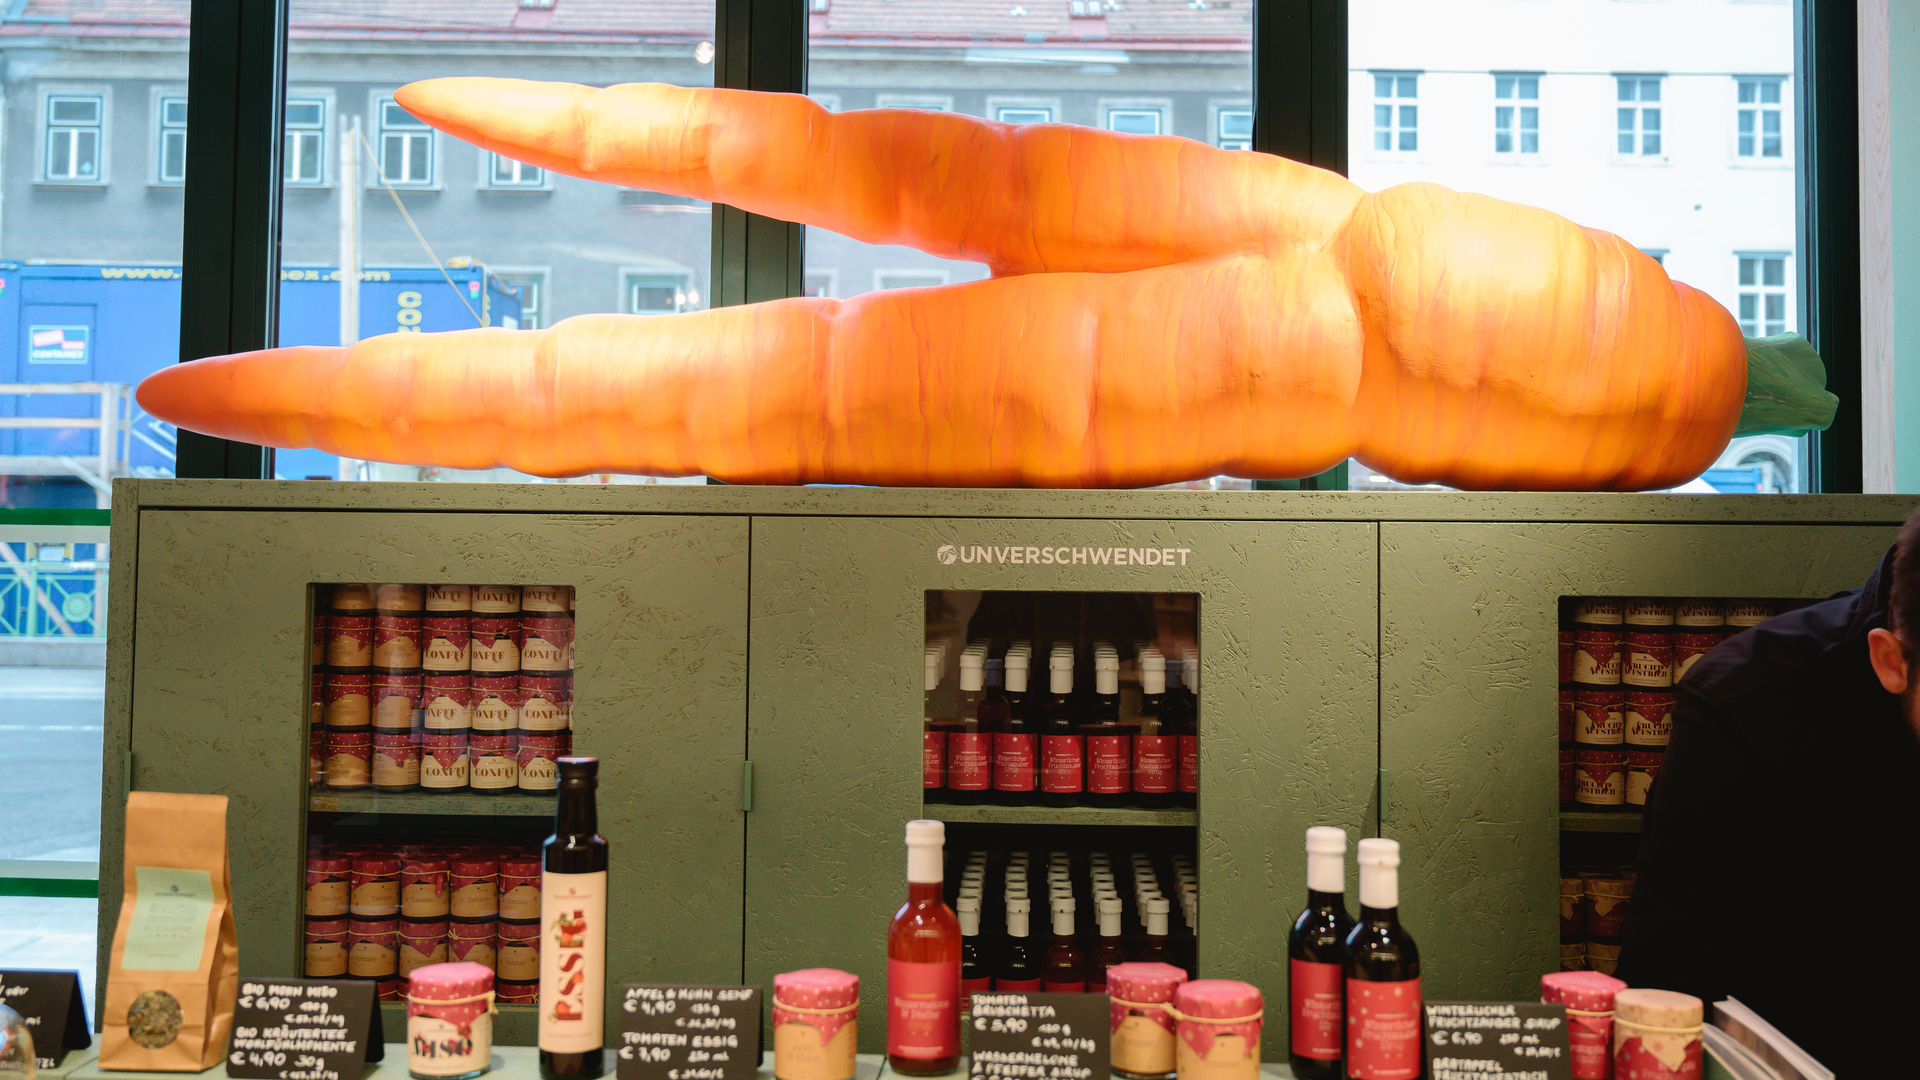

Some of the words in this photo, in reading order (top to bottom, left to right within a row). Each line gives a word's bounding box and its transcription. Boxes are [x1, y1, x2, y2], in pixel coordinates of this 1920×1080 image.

[960, 546, 1191, 566] UNVERSCHWENDET
[556, 910, 586, 1021] ESSIG
[242, 983, 265, 996] BIO
[625, 988, 665, 1000] APFEL
[238, 996, 254, 1009] €
[623, 999, 638, 1013] €
[971, 994, 1028, 1006] TOMATEN
[974, 1017, 987, 1031] €
[236, 1026, 258, 1039] BIO
[622, 1031, 688, 1046] TOMATEN
[692, 1034, 738, 1048] ESSIG
[230, 1051, 246, 1065] €
[249, 1051, 287, 1067] 4,90
[619, 1045, 634, 1060] €
[973, 1050, 1079, 1067] WASSERMELONE
[1050, 1066, 1092, 1079] SIRUP
